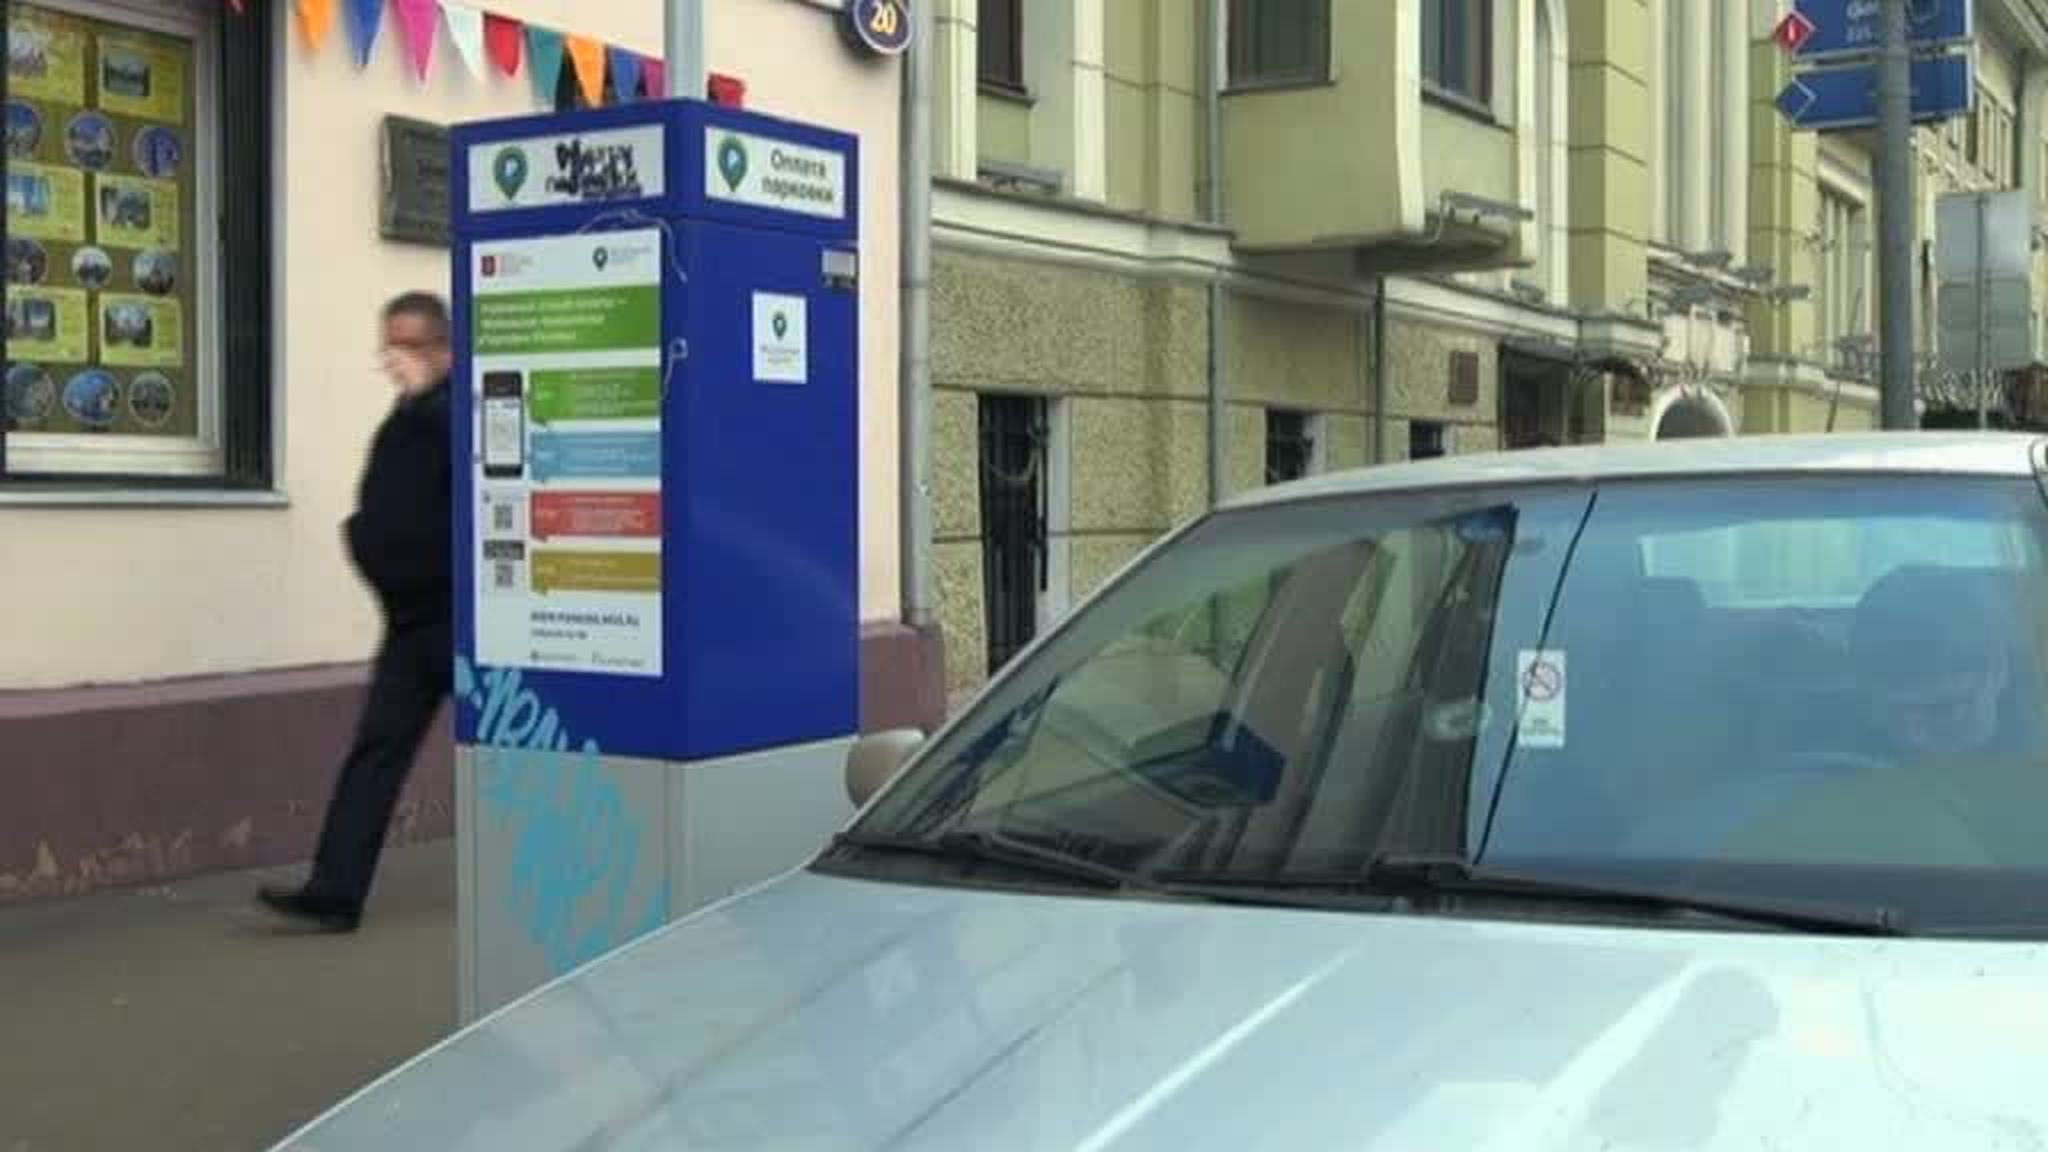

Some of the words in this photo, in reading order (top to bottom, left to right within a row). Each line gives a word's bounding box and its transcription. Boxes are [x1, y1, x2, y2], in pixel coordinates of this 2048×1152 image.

[869, 0, 898, 35] 20
[770, 148, 826, 178] Оплата
[761, 175, 834, 203] парковки
